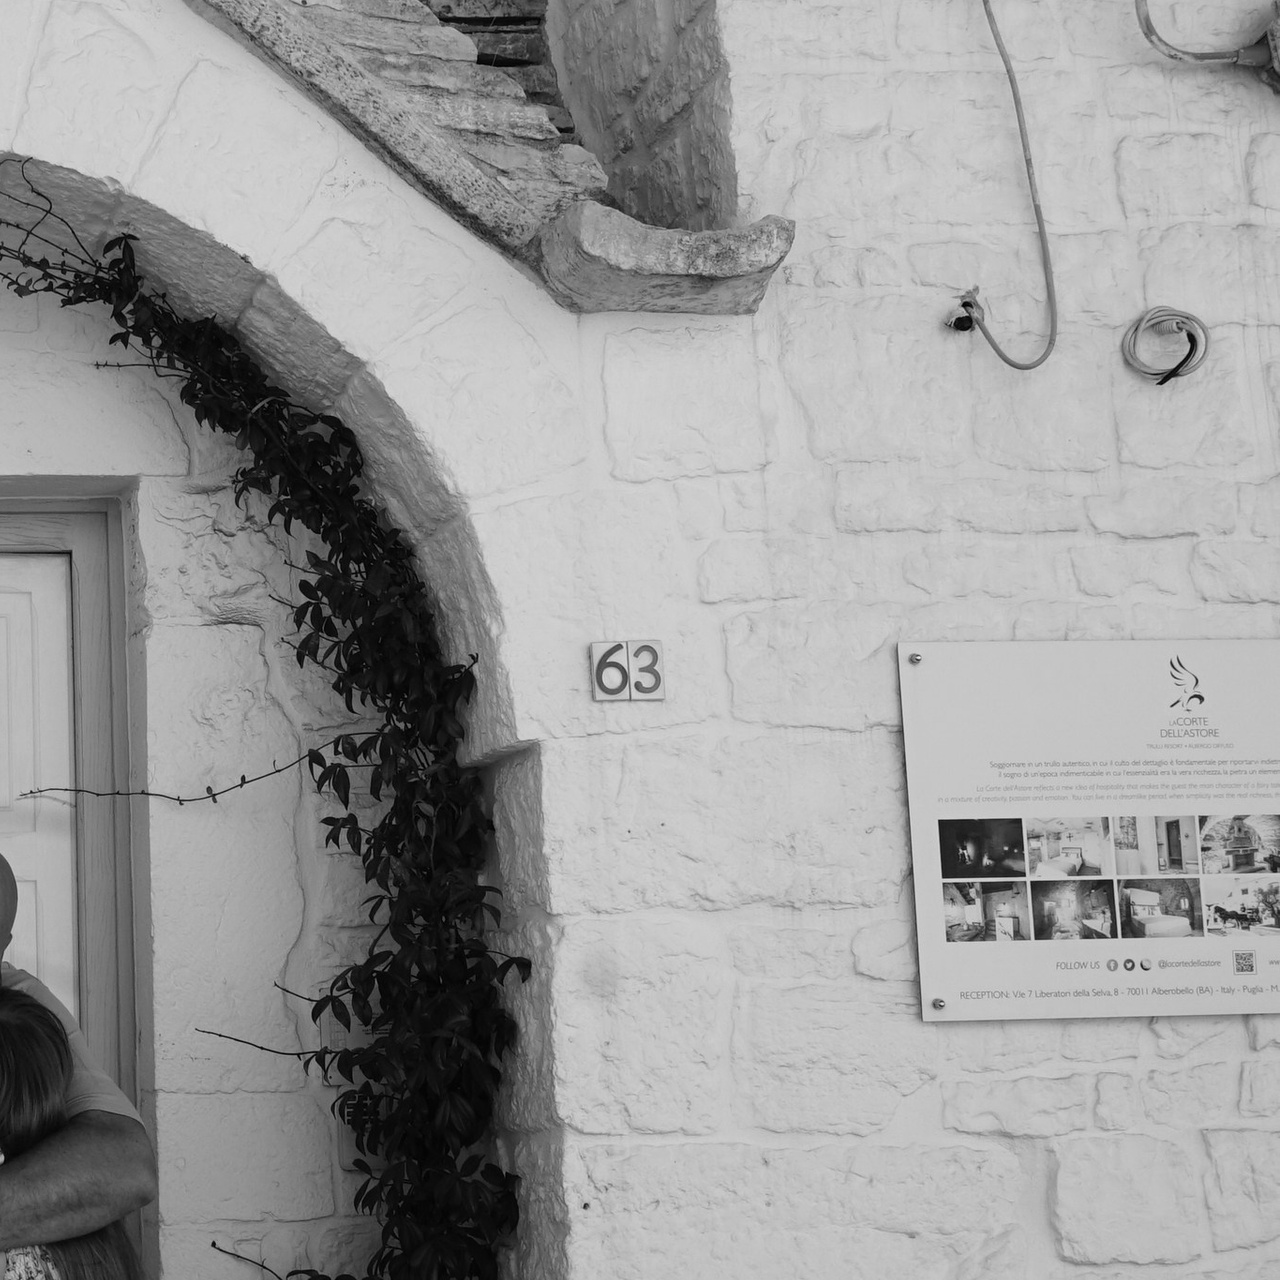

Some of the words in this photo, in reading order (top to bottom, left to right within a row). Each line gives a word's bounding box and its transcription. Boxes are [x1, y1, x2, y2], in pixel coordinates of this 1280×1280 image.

[596, 643, 661, 695] 63
[1160, 729, 1219, 738] DELL'ASTORE
[1056, 961, 1088, 970] FOLLOW
[1089, 960, 1100, 969] US
[1073, 989, 1090, 997] della
[1126, 987, 1149, 995] 70011
[1151, 987, 1194, 995] Alberobello
[1196, 986, 1214, 996] (BA)
[1220, 986, 1236, 995] Italy
[1242, 985, 1264, 995] Puglia
